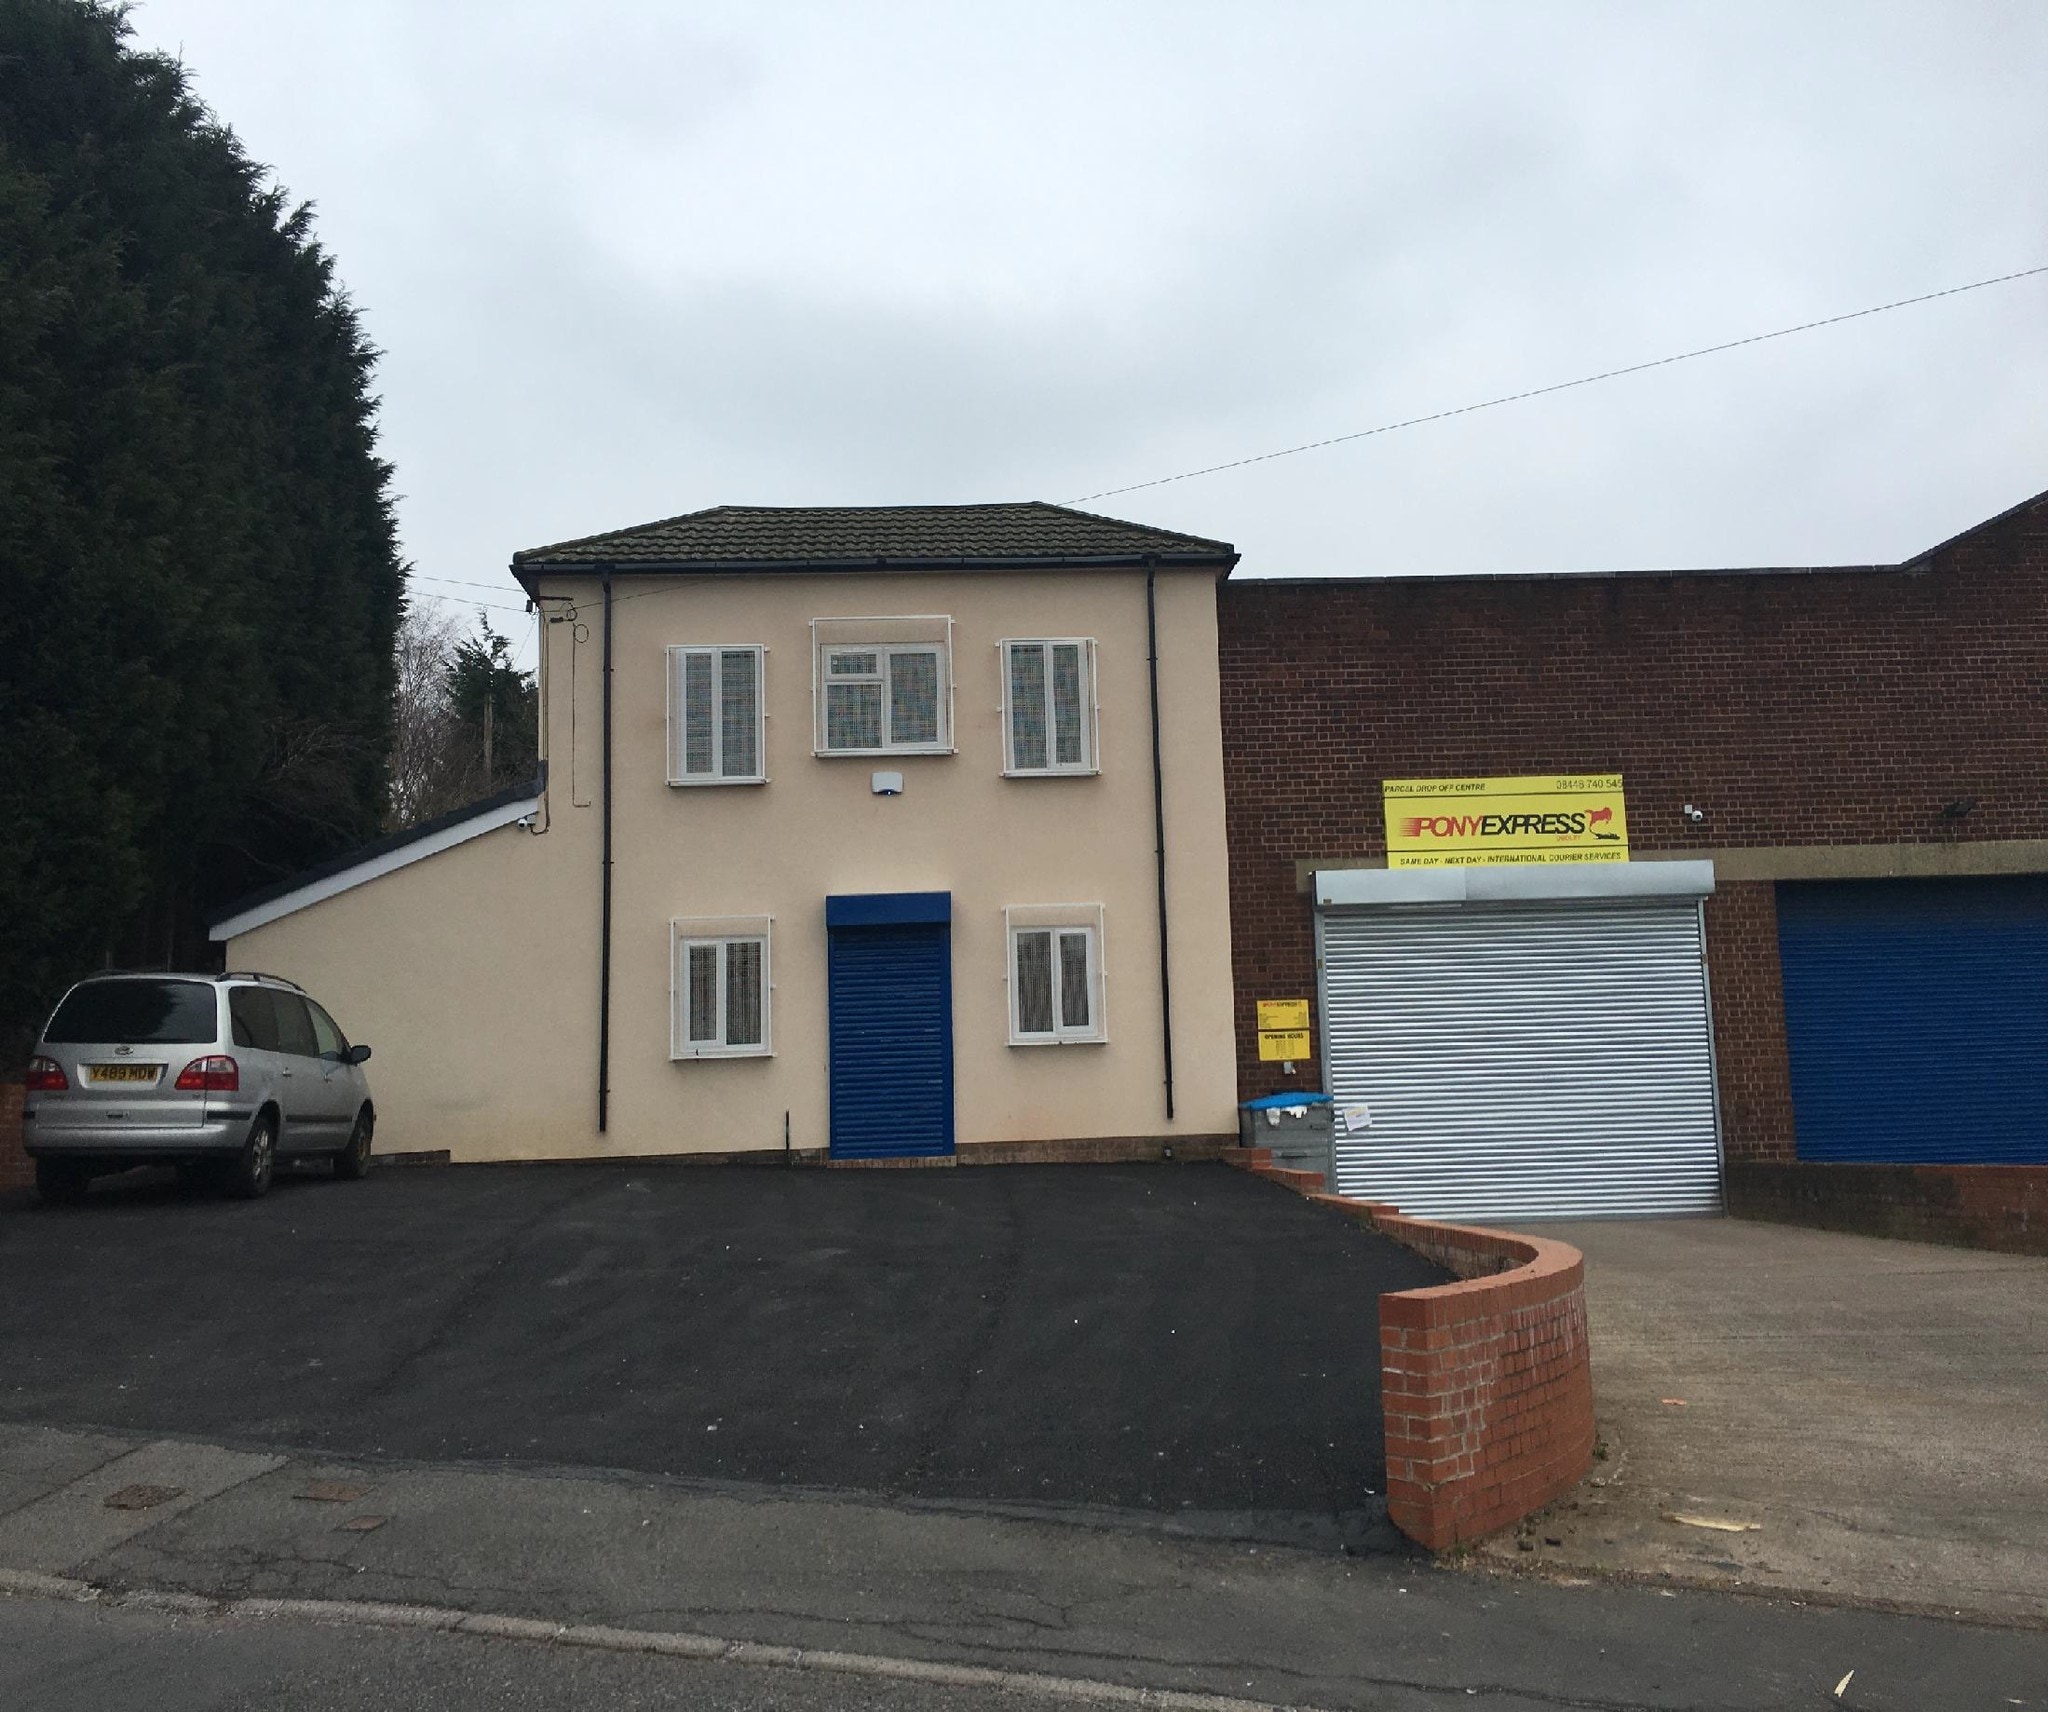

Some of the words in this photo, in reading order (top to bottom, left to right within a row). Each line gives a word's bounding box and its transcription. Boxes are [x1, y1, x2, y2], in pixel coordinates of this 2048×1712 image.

[1455, 783, 1486, 791] CENTRE
[1587, 779, 1604, 788] 740
[1466, 856, 1482, 864] DAY
[1487, 854, 1546, 863] INTERNATIONAL
[1549, 853, 1583, 861] COURIER
[1584, 852, 1621, 860] SERVICES
